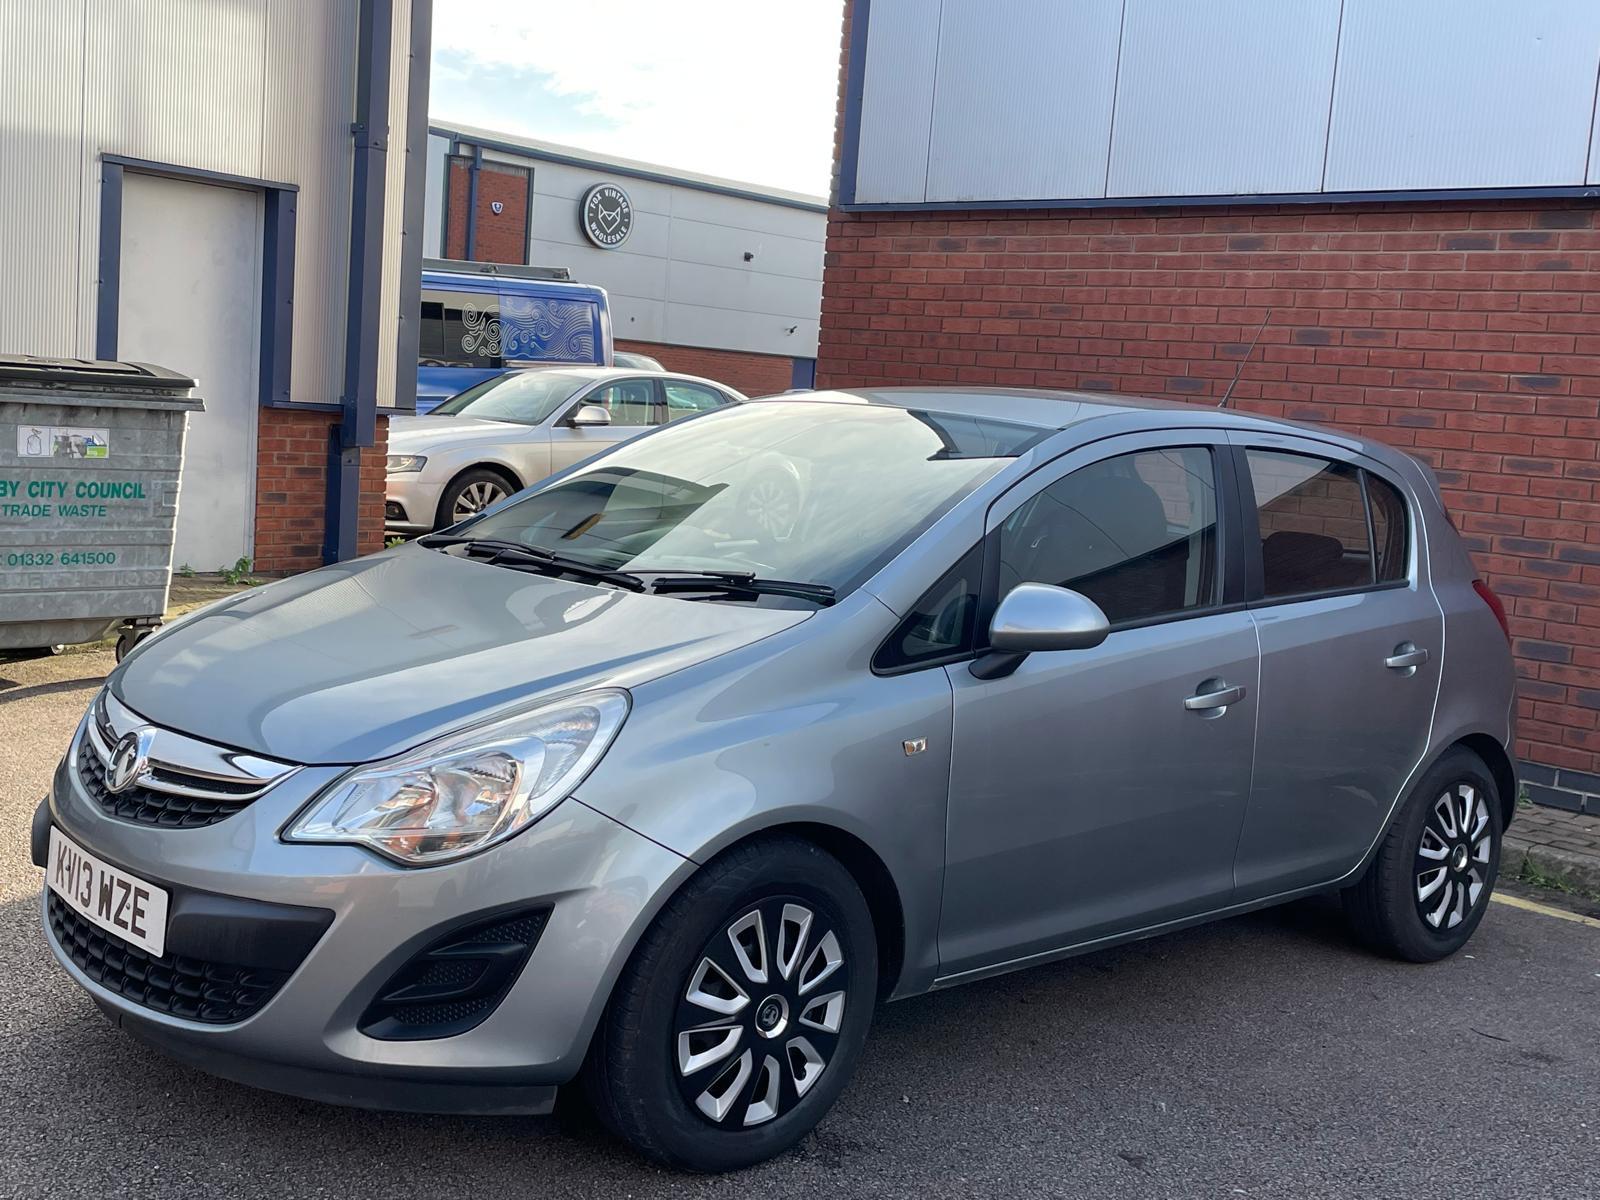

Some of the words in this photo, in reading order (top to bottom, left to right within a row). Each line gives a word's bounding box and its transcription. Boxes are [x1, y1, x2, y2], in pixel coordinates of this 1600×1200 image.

[590, 192, 602, 209] FOX
[604, 189, 629, 213] VINTAGE
[590, 222, 627, 243] WHOLESALE
[28, 481, 68, 498] CITY
[75, 481, 146, 499] COUNCIL
[2, 504, 51, 517] TRADE
[58, 504, 107, 517] WASTE
[7, 553, 54, 566] 01332
[61, 552, 116, 565] 641500
[55, 841, 93, 908] KV13
[98, 870, 149, 939] WZE
